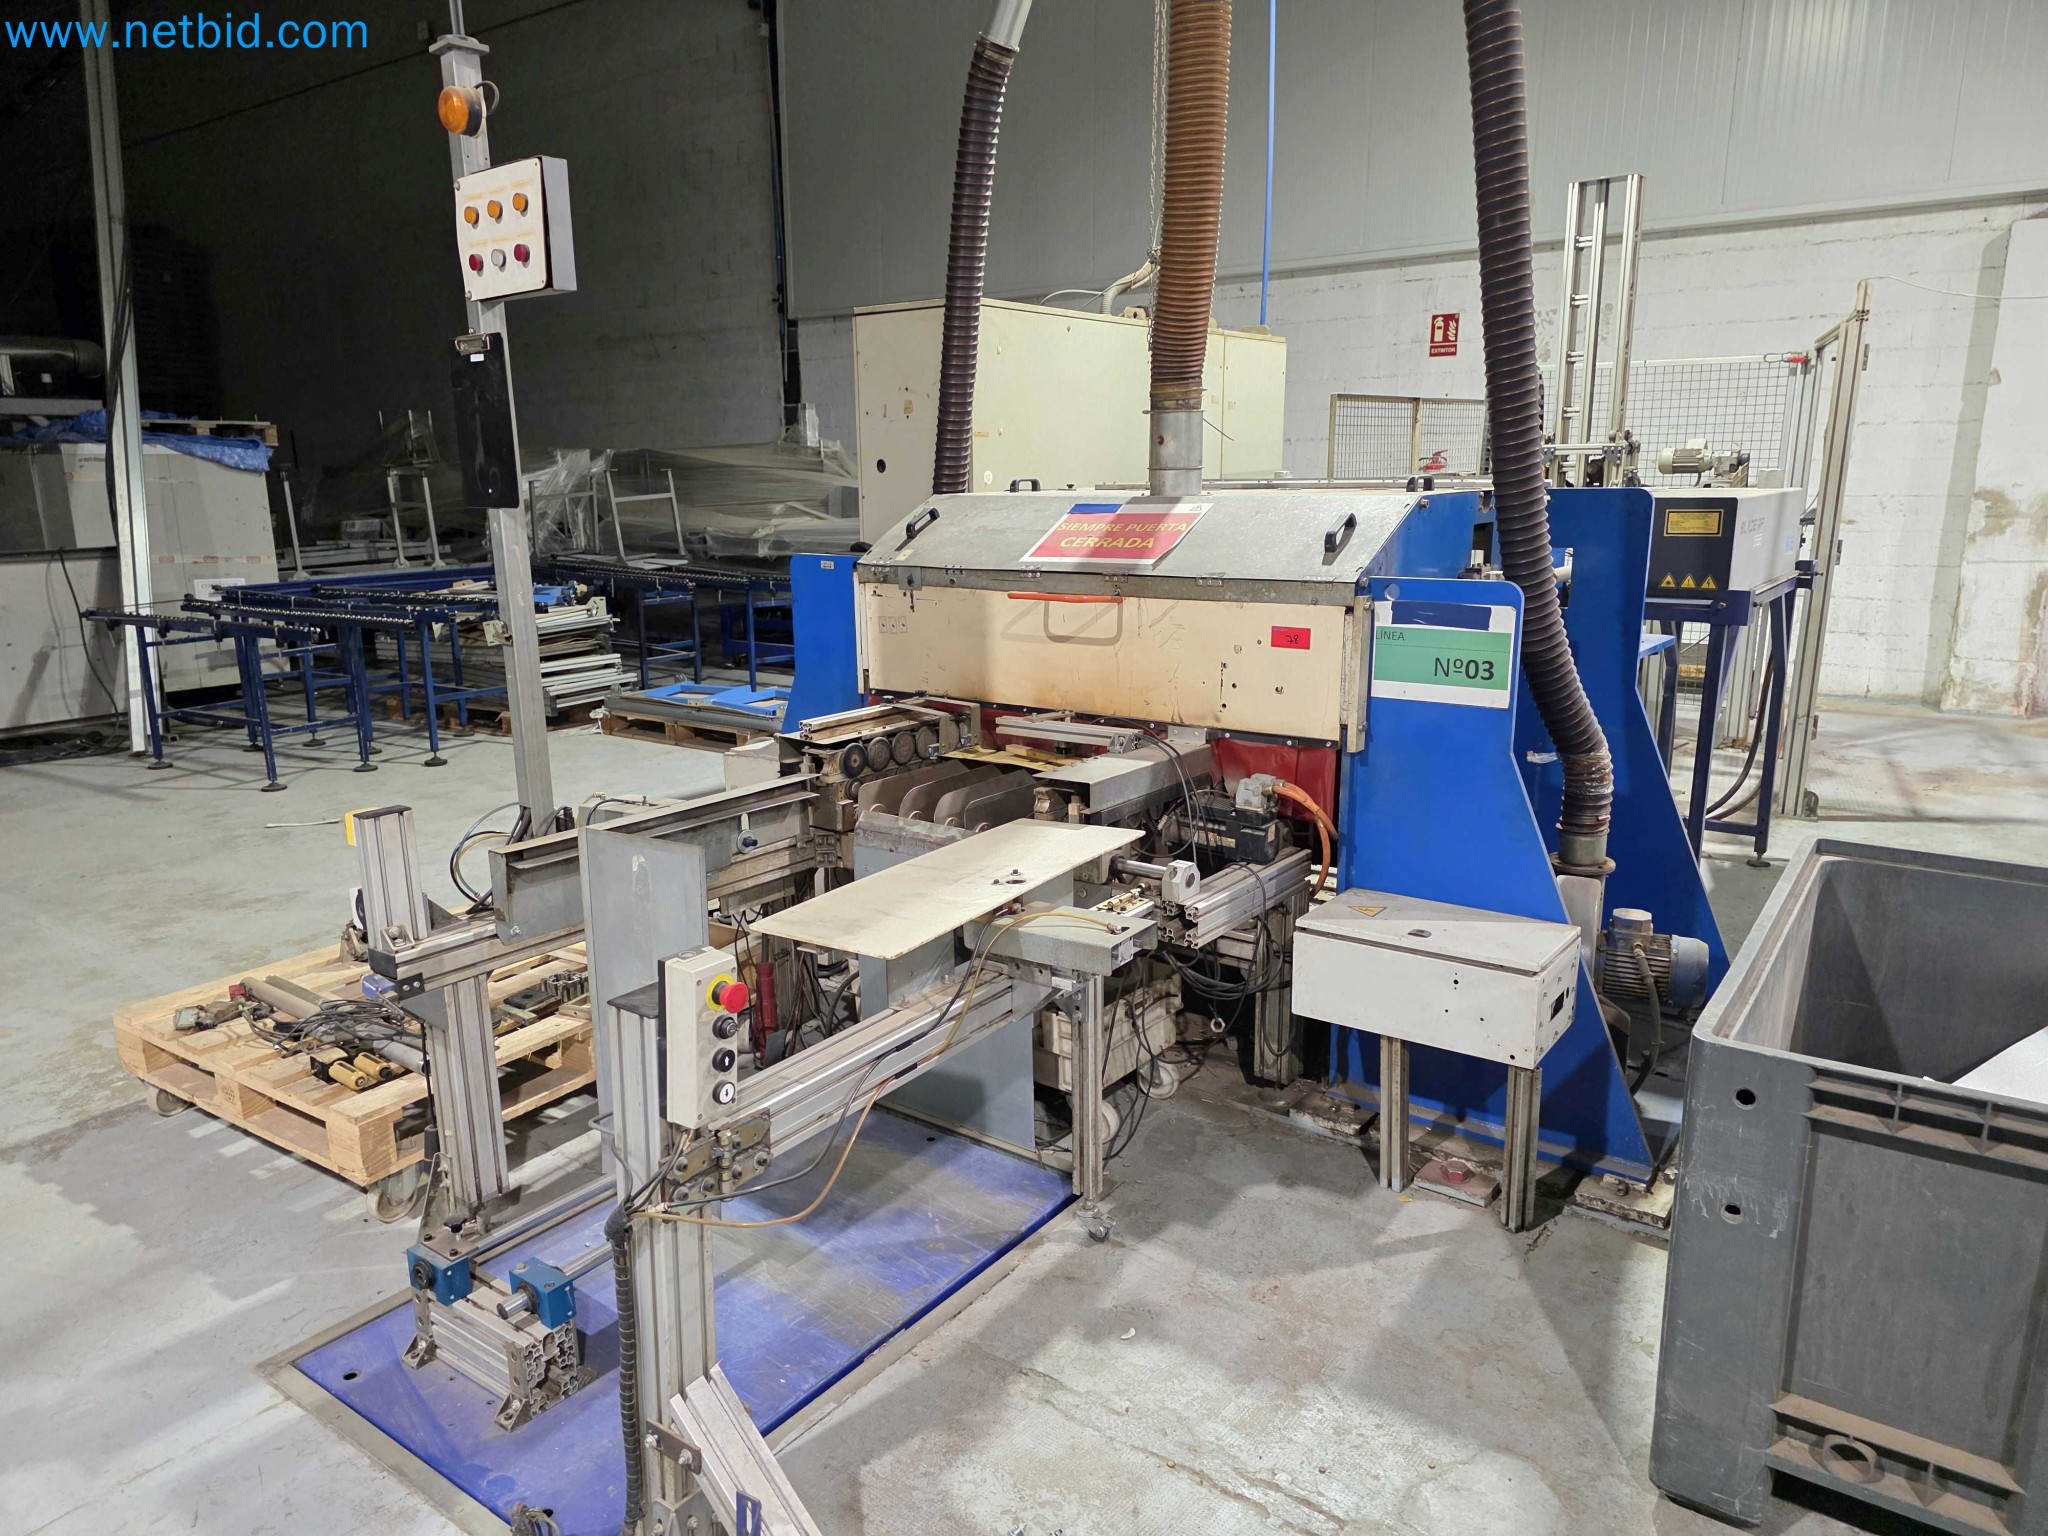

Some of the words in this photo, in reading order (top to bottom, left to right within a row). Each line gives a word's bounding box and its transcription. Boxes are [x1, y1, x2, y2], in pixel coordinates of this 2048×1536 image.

[1056, 522, 1123, 532] SIEMPRE
[1125, 522, 1188, 532] PUERTA
[1060, 537, 1156, 548] CERRADA
[1376, 628, 1405, 641] LÍNEA
